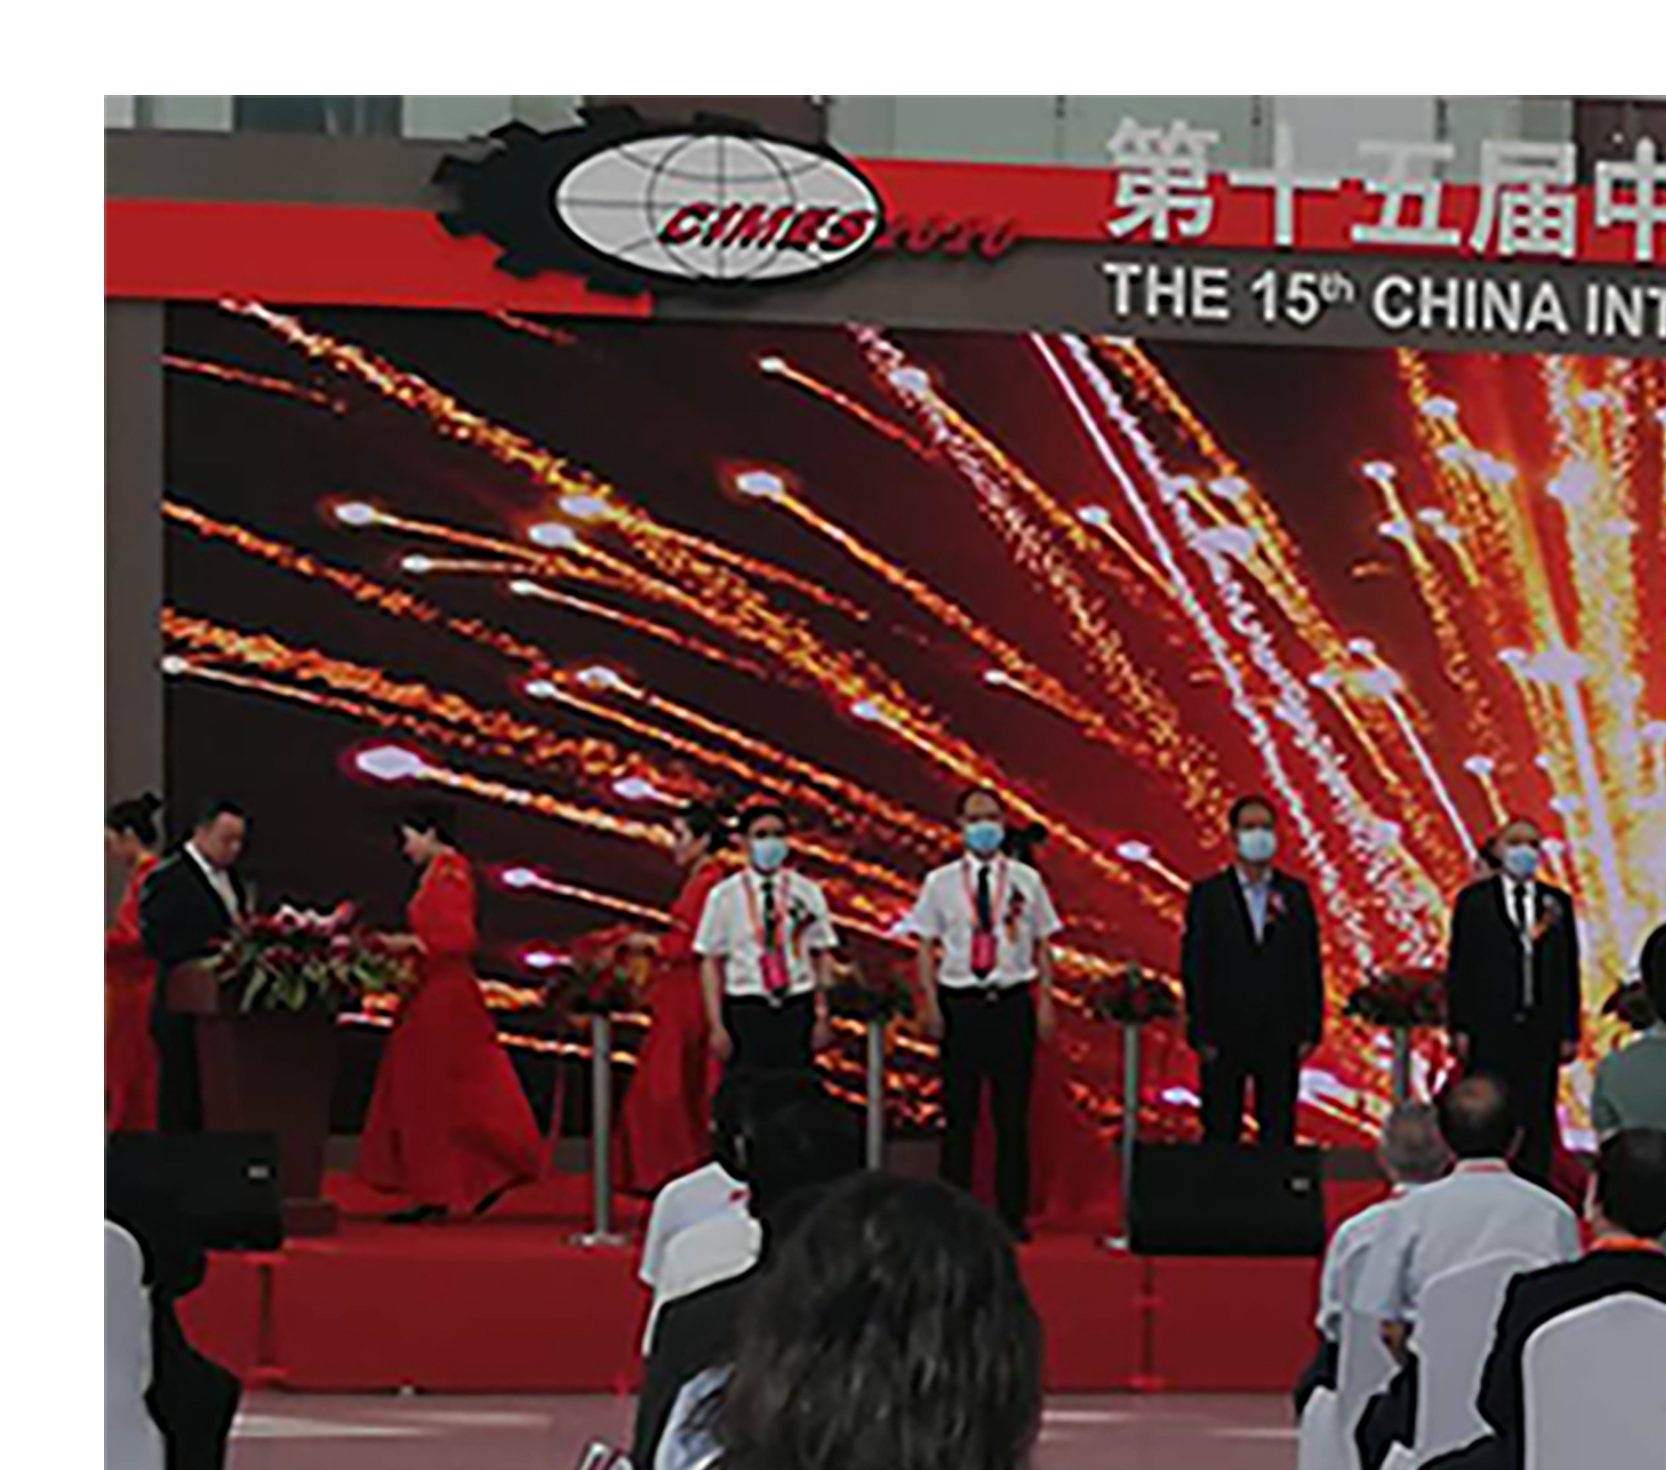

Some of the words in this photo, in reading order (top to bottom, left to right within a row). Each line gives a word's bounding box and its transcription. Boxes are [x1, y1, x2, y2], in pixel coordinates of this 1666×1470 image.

[655, 201, 874, 251] CIMES
[1104, 262, 1231, 321] THE
[1252, 270, 1354, 324] 15th
[1372, 274, 1568, 334] CHINA
